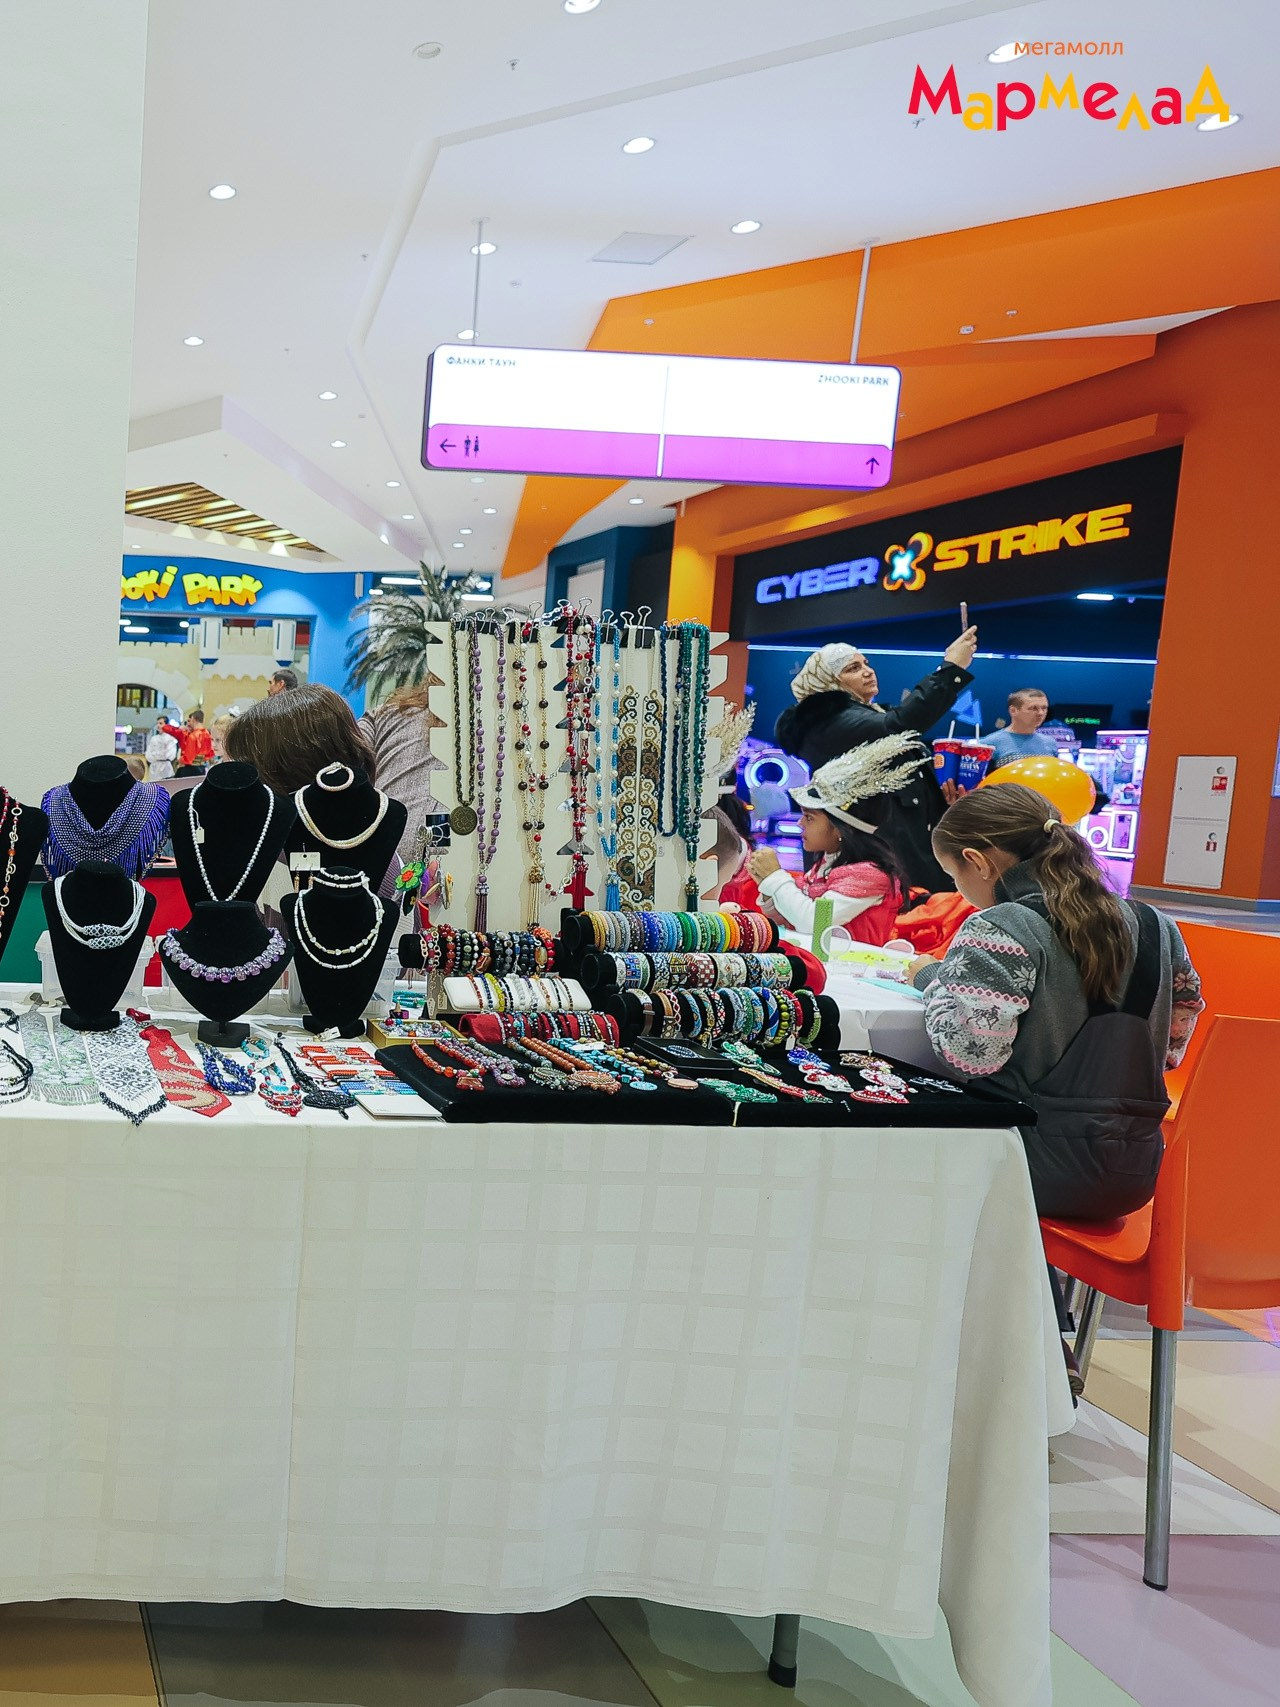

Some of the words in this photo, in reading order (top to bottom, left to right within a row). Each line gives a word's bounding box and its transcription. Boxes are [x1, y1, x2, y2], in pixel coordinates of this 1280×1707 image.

[446, 356, 486, 366] ФАНКИ
[862, 376, 890, 386] PARK
[755, 555, 881, 604] CYBER
[932, 503, 1133, 572] STRIKE
[182, 572, 264, 606] PARK
